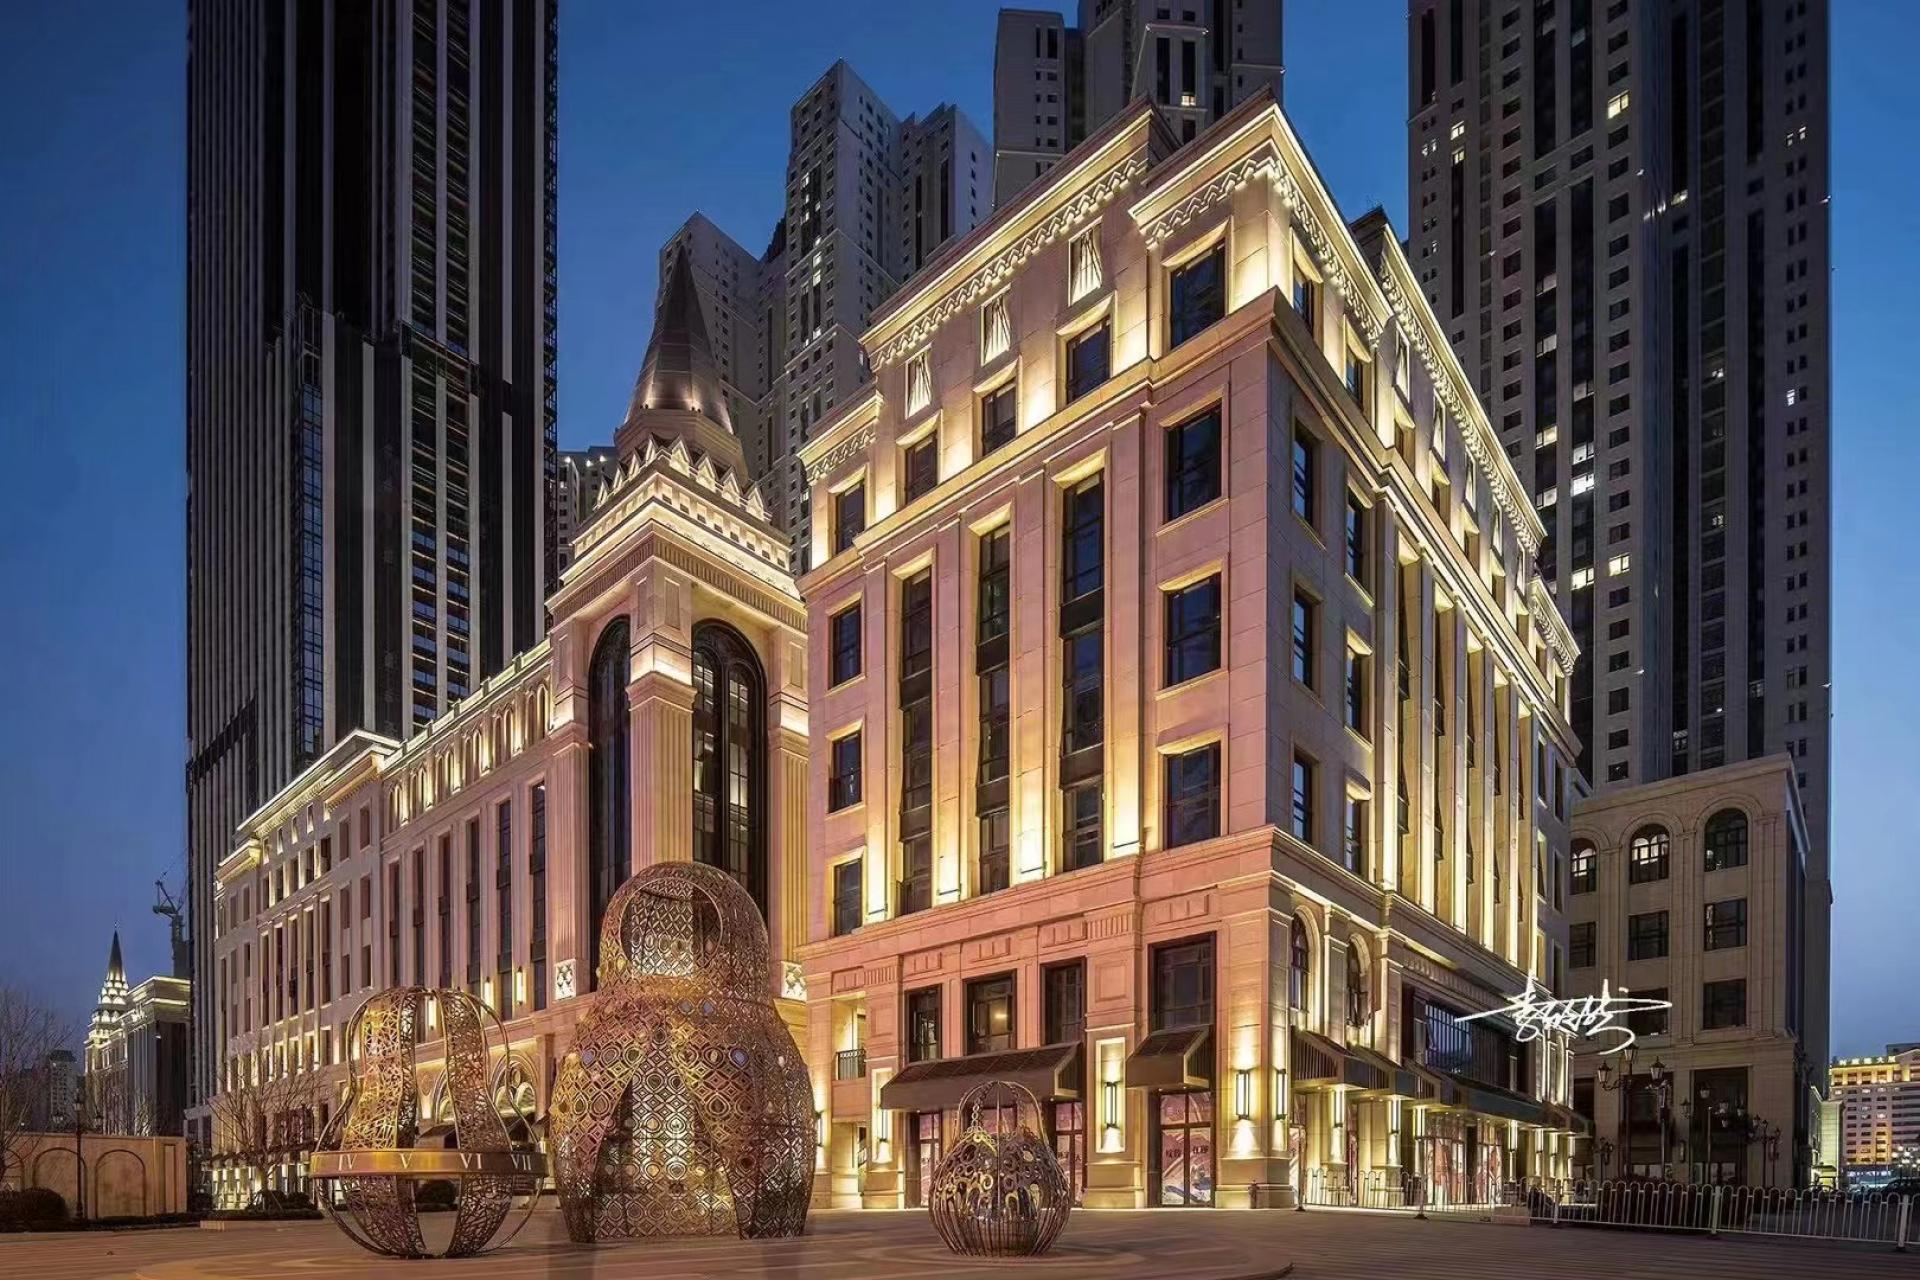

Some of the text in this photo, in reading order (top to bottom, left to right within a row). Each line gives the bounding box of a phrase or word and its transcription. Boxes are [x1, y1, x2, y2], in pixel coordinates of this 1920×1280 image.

[338, 1153, 531, 1171] IV V VI VII
